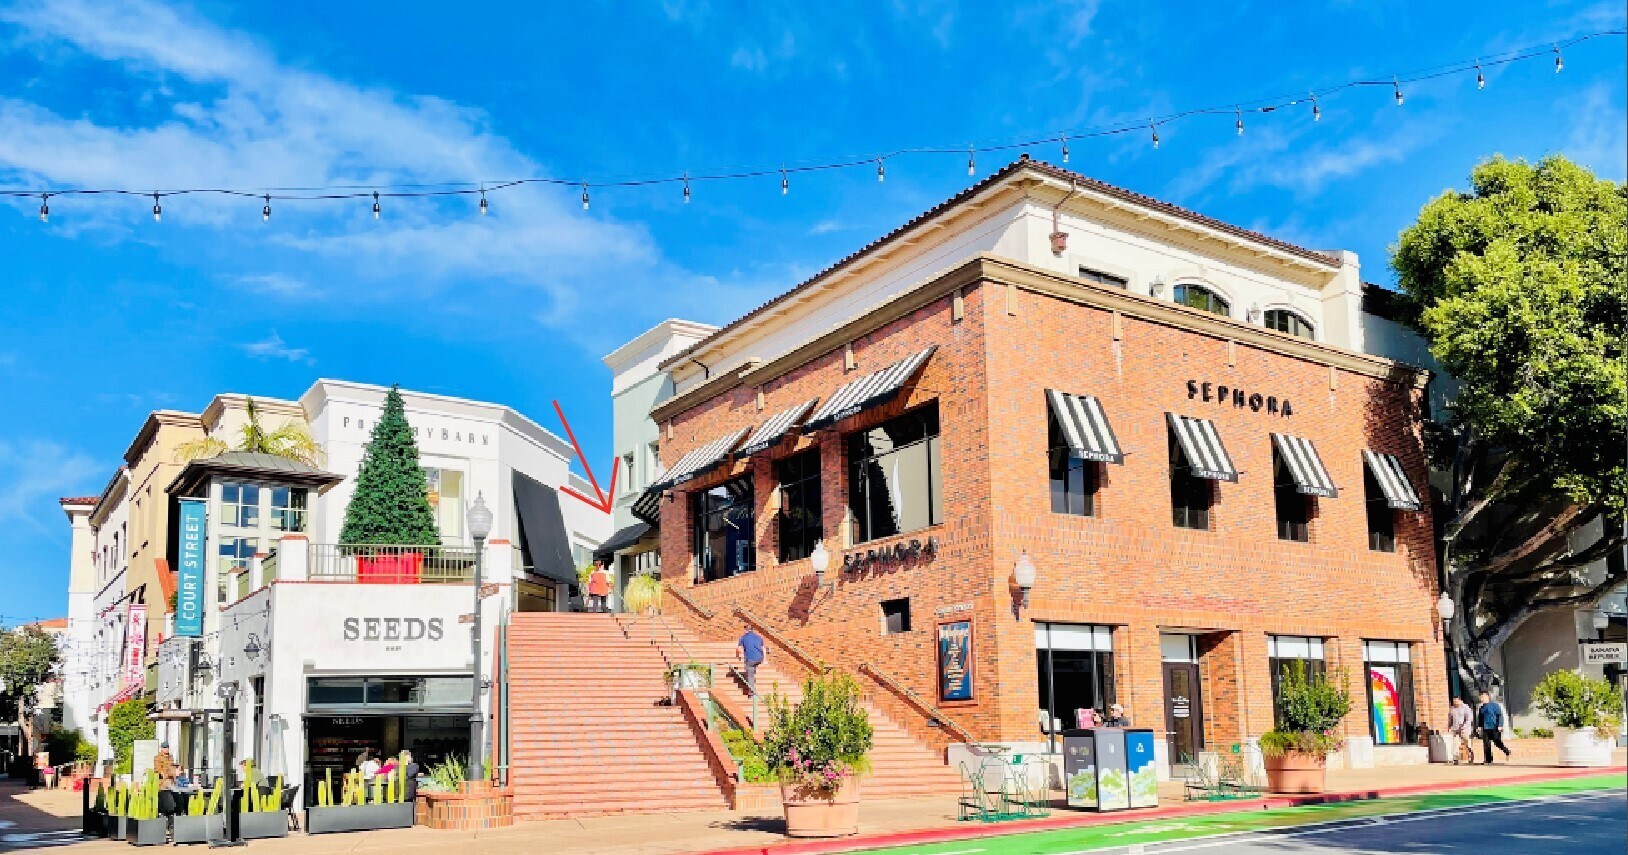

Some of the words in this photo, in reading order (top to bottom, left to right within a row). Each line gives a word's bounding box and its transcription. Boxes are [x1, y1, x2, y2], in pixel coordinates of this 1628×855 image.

[1186, 379, 1293, 419] SEPHORA
[184, 513, 199, 569] STREET
[843, 536, 938, 573] SEPHORA
[183, 572, 197, 621] COURT
[343, 617, 444, 641] SEEDS
